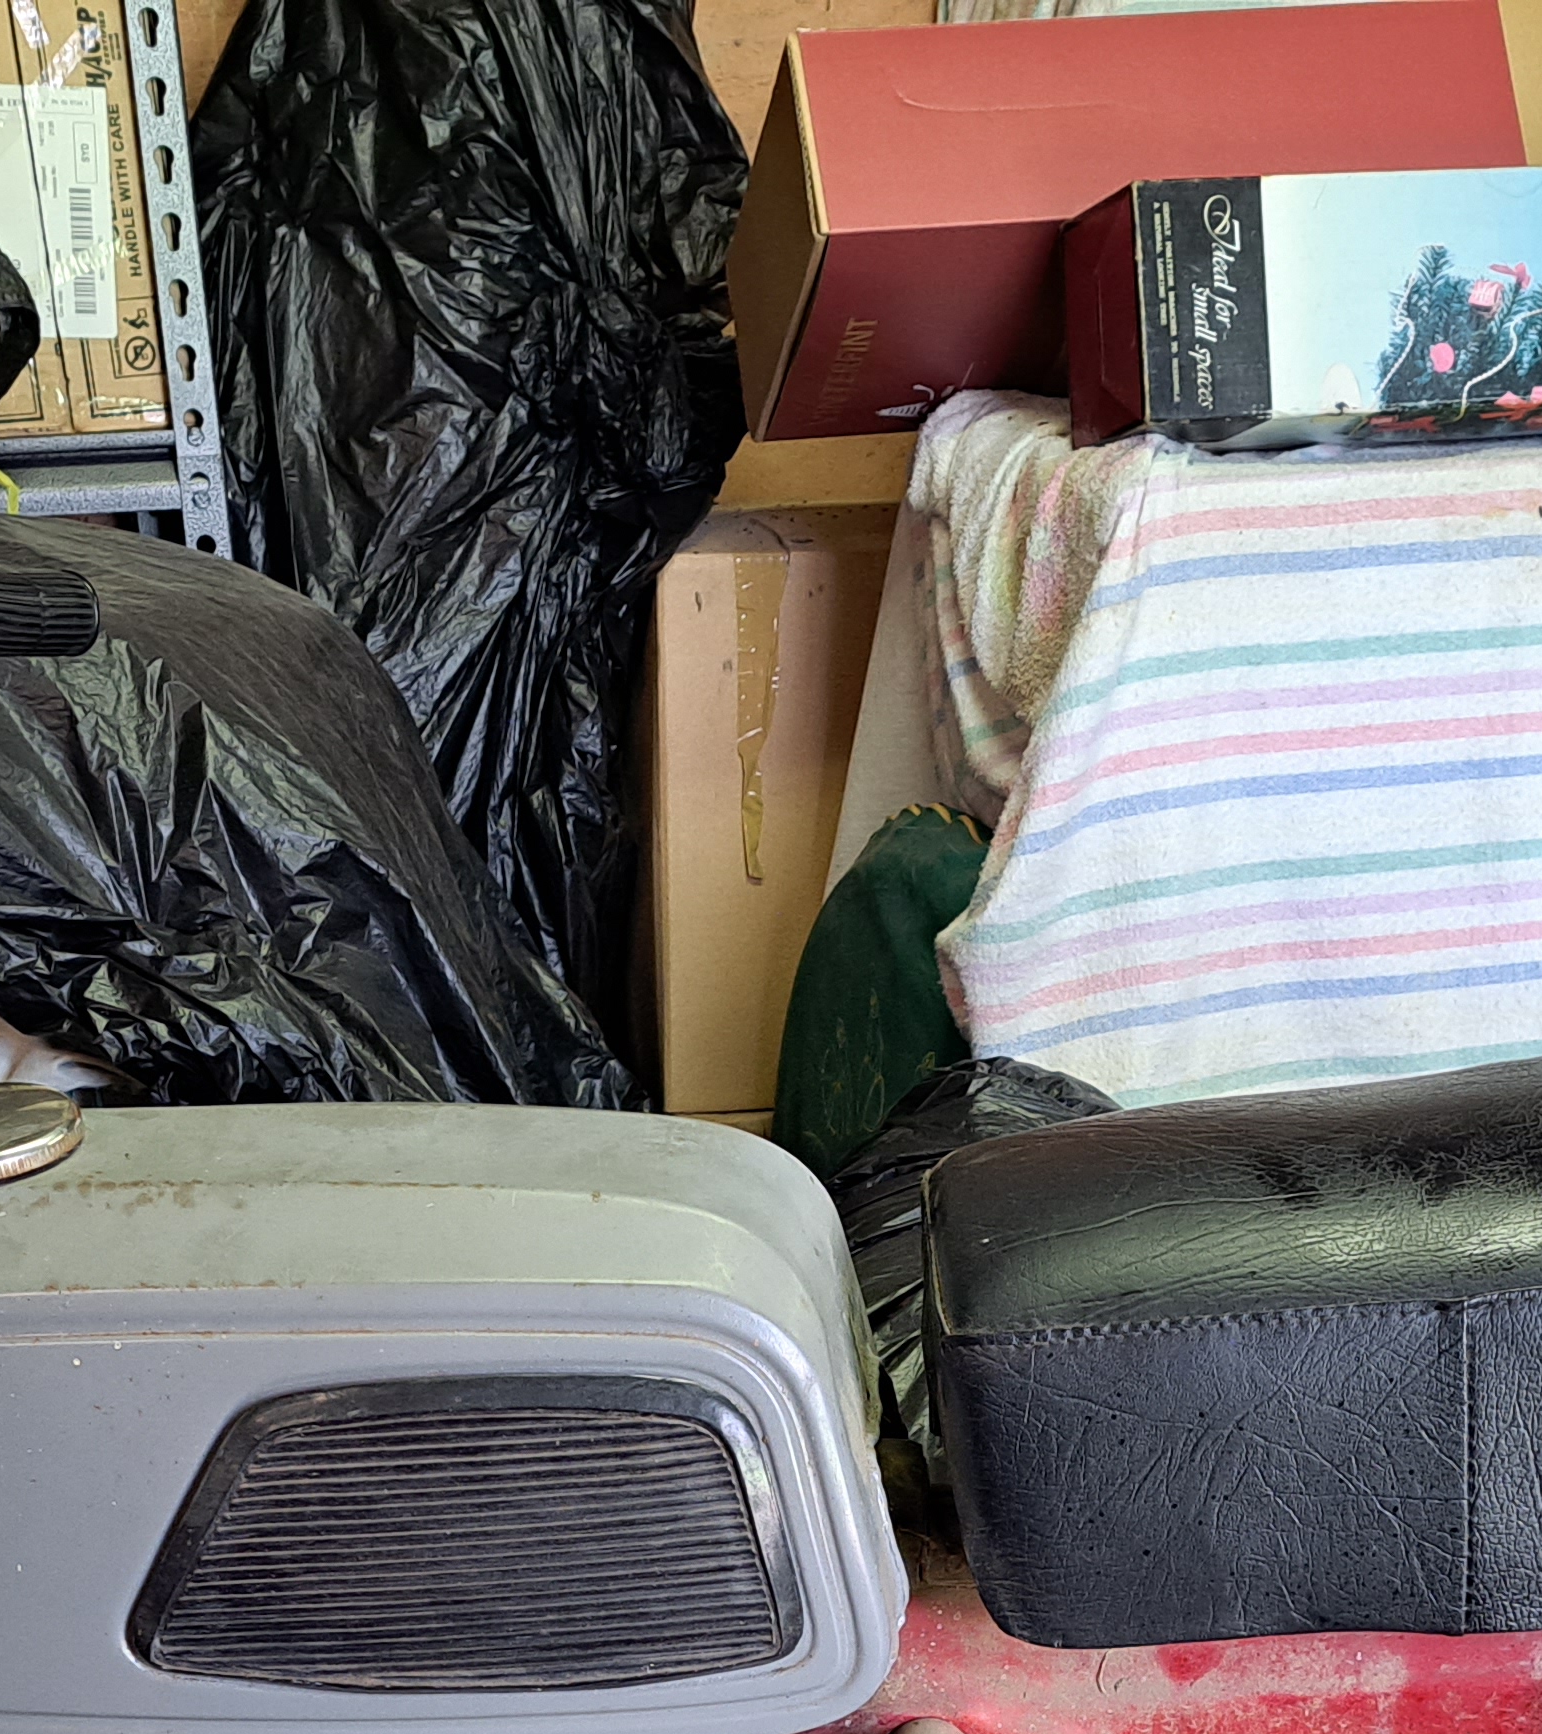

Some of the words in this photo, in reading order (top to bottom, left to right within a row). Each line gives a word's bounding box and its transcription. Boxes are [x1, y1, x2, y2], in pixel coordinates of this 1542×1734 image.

[80, 143, 91, 162] SYD
[108, 103, 125, 152] CARE
[113, 158, 132, 202] WITH
[120, 207, 143, 278] HANDLE
[1203, 194, 1242, 293] Ideal
[1191, 282, 1217, 342] small
[1208, 293, 1239, 330] for
[1188, 344, 1216, 413] spaces
